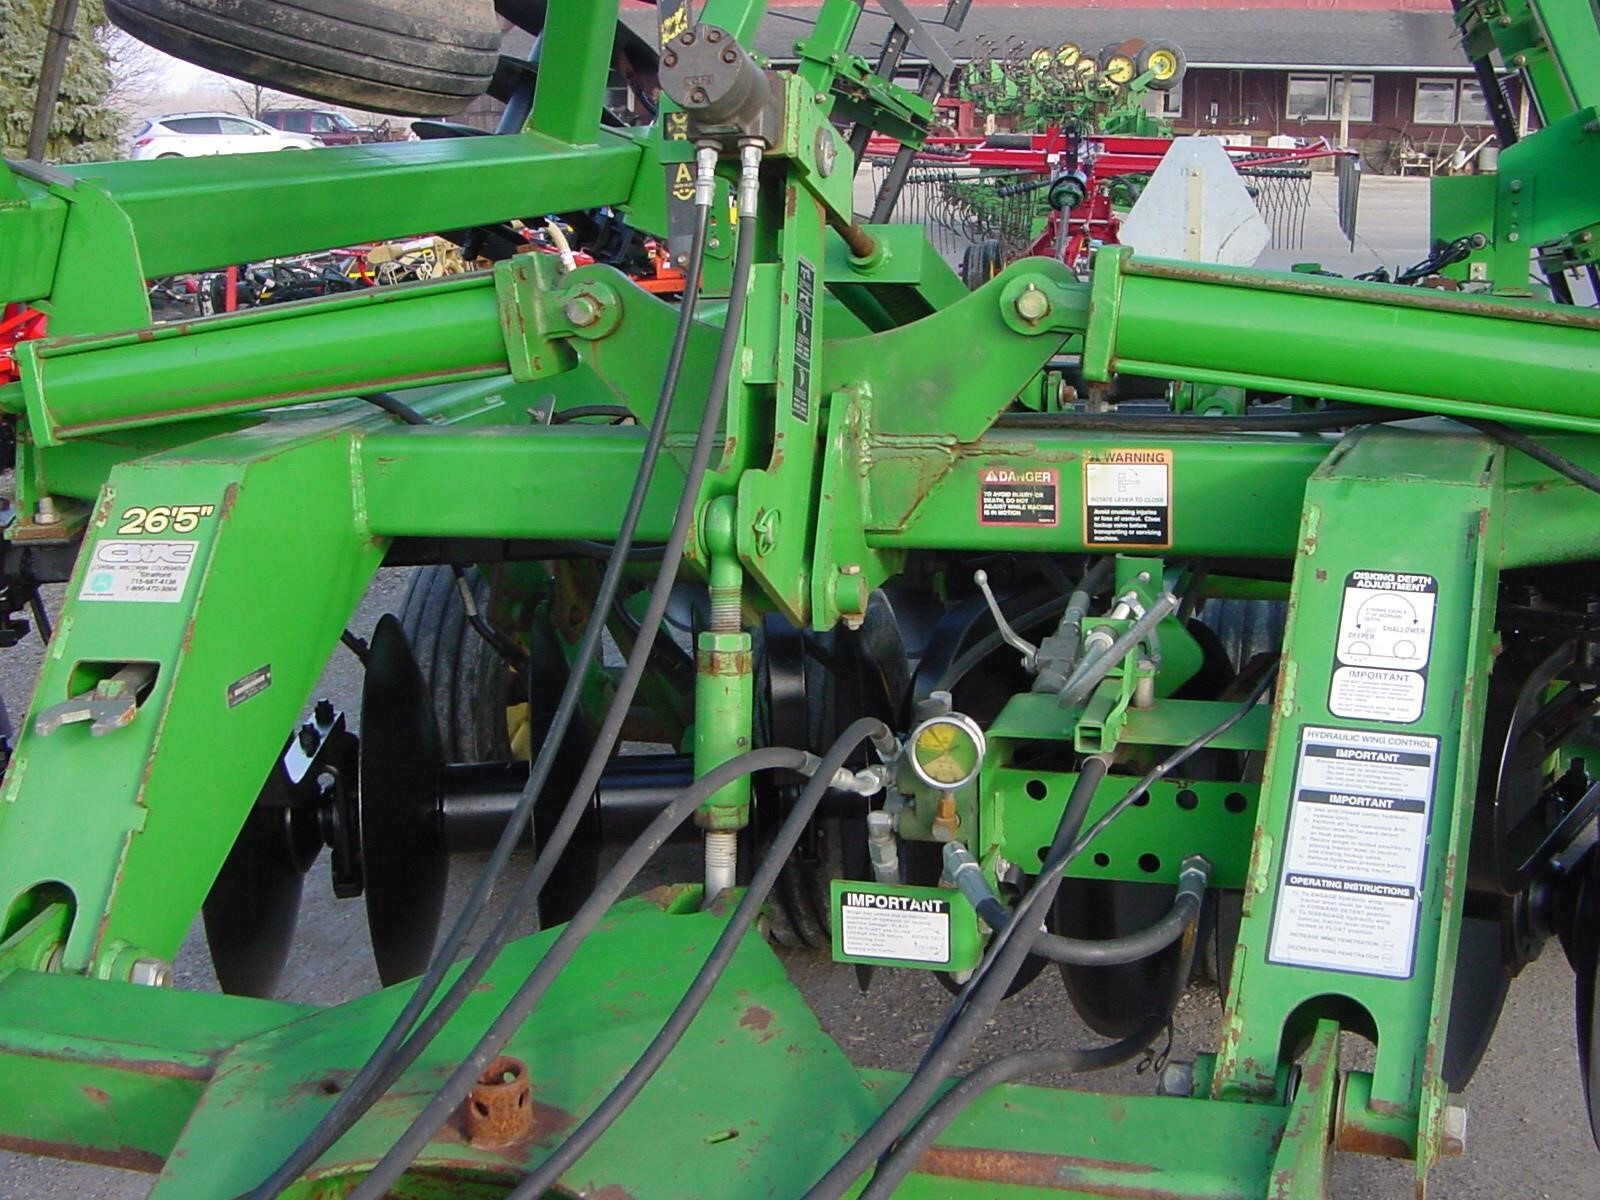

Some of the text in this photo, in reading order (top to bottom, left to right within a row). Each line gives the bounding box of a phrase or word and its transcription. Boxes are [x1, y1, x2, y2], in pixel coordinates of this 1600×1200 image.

[1104, 452, 1165, 463] WARNING
[999, 471, 1051, 482] DANGER
[117, 504, 216, 535] 26'5"
[1353, 572, 1432, 584] DISKING DEPTH
[1356, 580, 1426, 592] ADJUSTMENT
[1349, 670, 1411, 682] IMPORTANT
[1307, 730, 1433, 749] HYDRAULIC WING CONTROL
[1335, 748, 1400, 762] IMPORTANT
[1329, 794, 1394, 809] IMPORTANT
[1290, 876, 1411, 897] OPERATING INSTRUCTIONS
[847, 893, 944, 913] IMPORTANT
